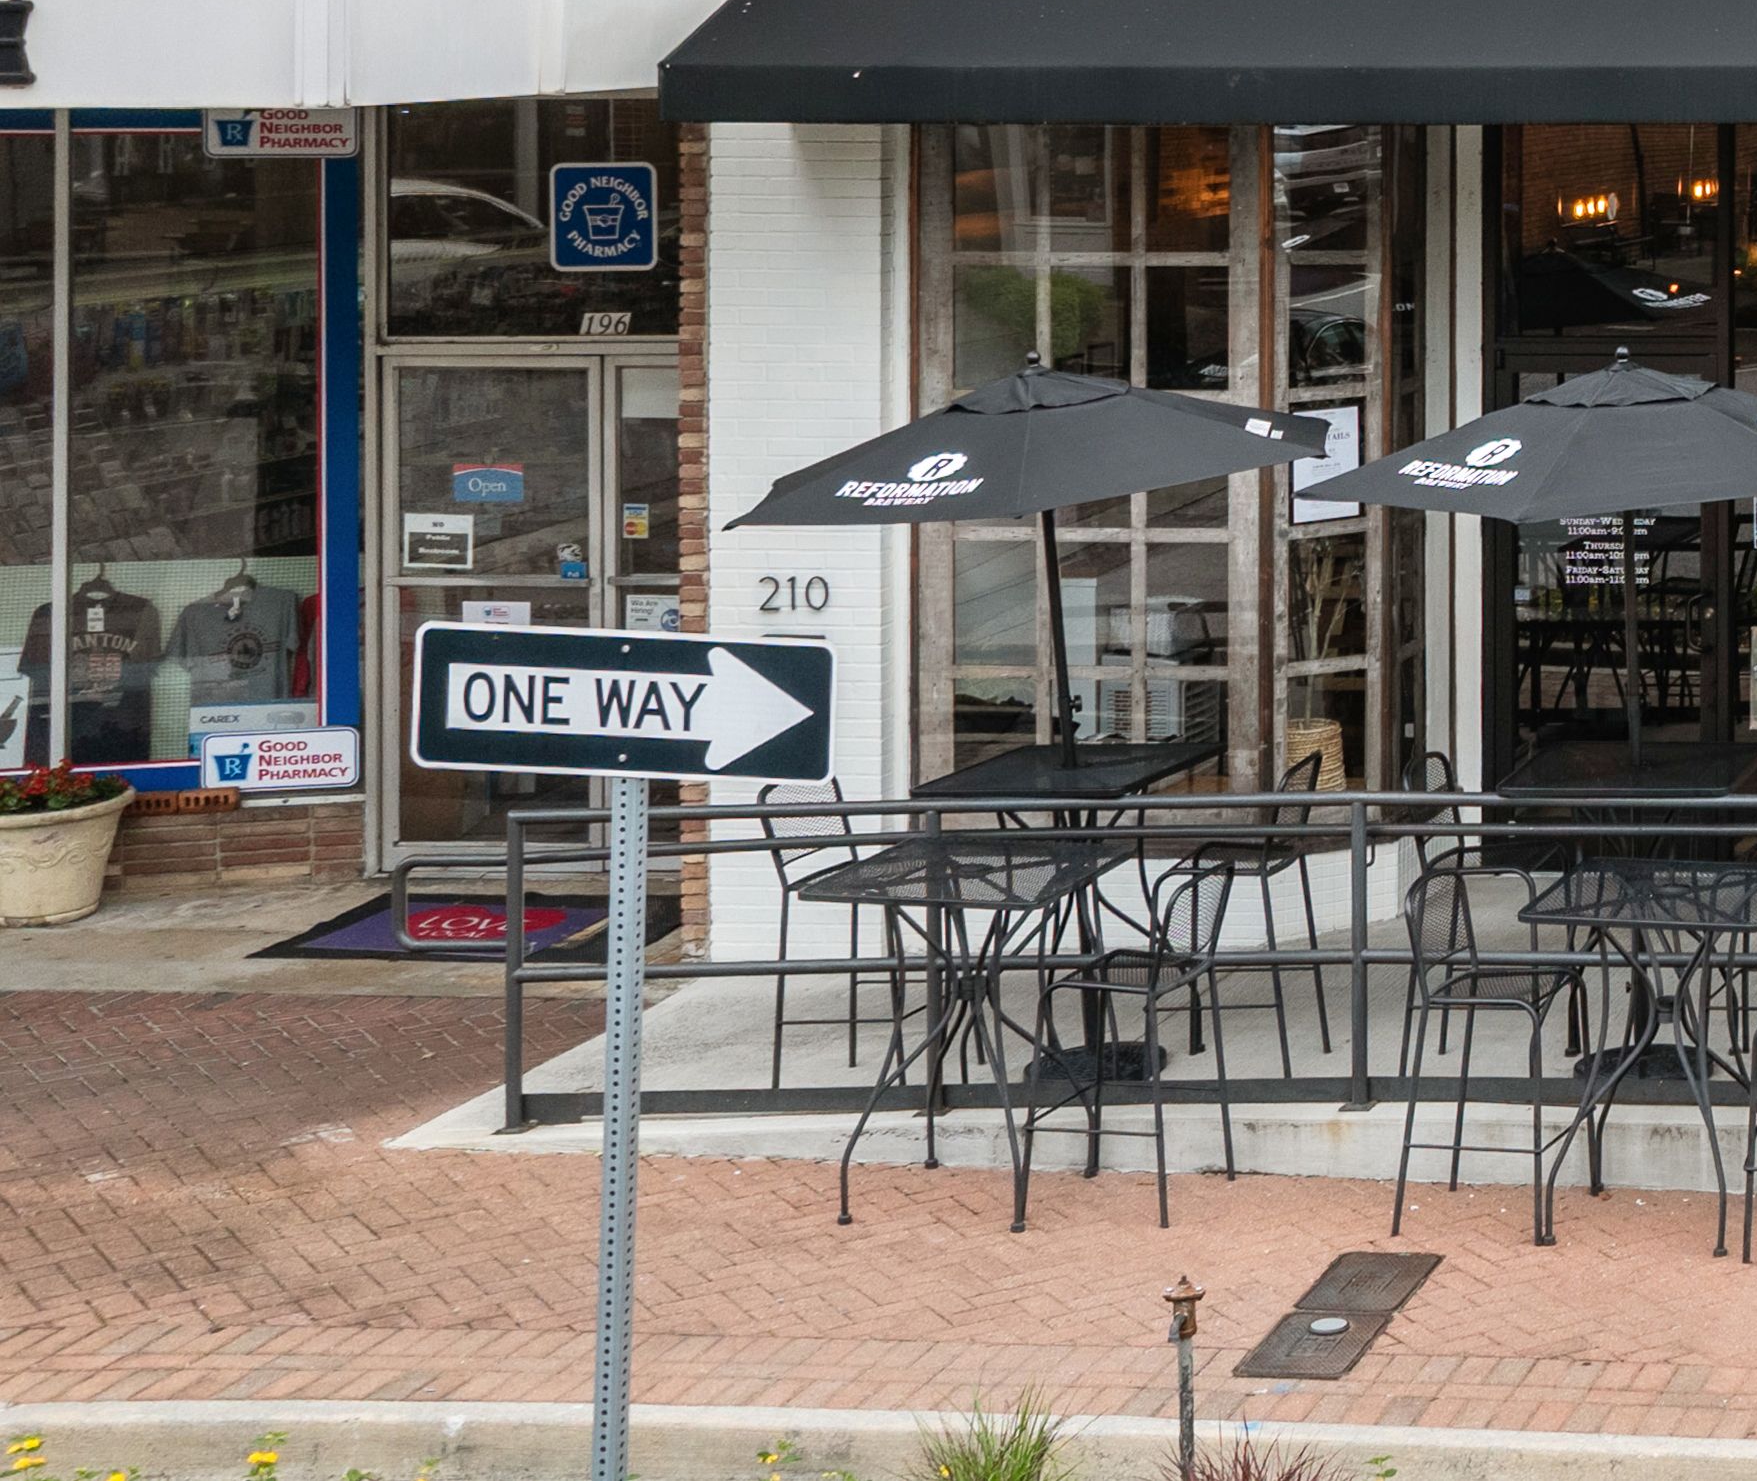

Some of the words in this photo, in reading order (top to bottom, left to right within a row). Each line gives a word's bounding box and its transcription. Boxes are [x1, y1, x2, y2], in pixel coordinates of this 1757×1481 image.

[260, 108, 308, 120] GOOD
[260, 122, 343, 134] NEIGHBOR
[260, 136, 349, 148] PHARMACY
[559, 182, 587, 222] GOOD
[590, 176, 649, 220] NEIGHBOR
[567, 230, 641, 258] PHARMACY
[585, 314, 628, 335] 196
[1398, 459, 1519, 486] REFORMATION
[468, 477, 507, 497] Open
[834, 478, 985, 498] REFORMATION
[862, 496, 935, 506] BREWERY
[760, 577, 829, 611] 210
[72, 632, 138, 653] ANTON
[464, 672, 570, 725] ONE
[596, 679, 706, 731] WAY
[200, 715, 240, 724] CAREX
[258, 740, 308, 753] GOOD
[258, 753, 343, 767] NEIGHBOR
[258, 767, 348, 781] PHARMACY
